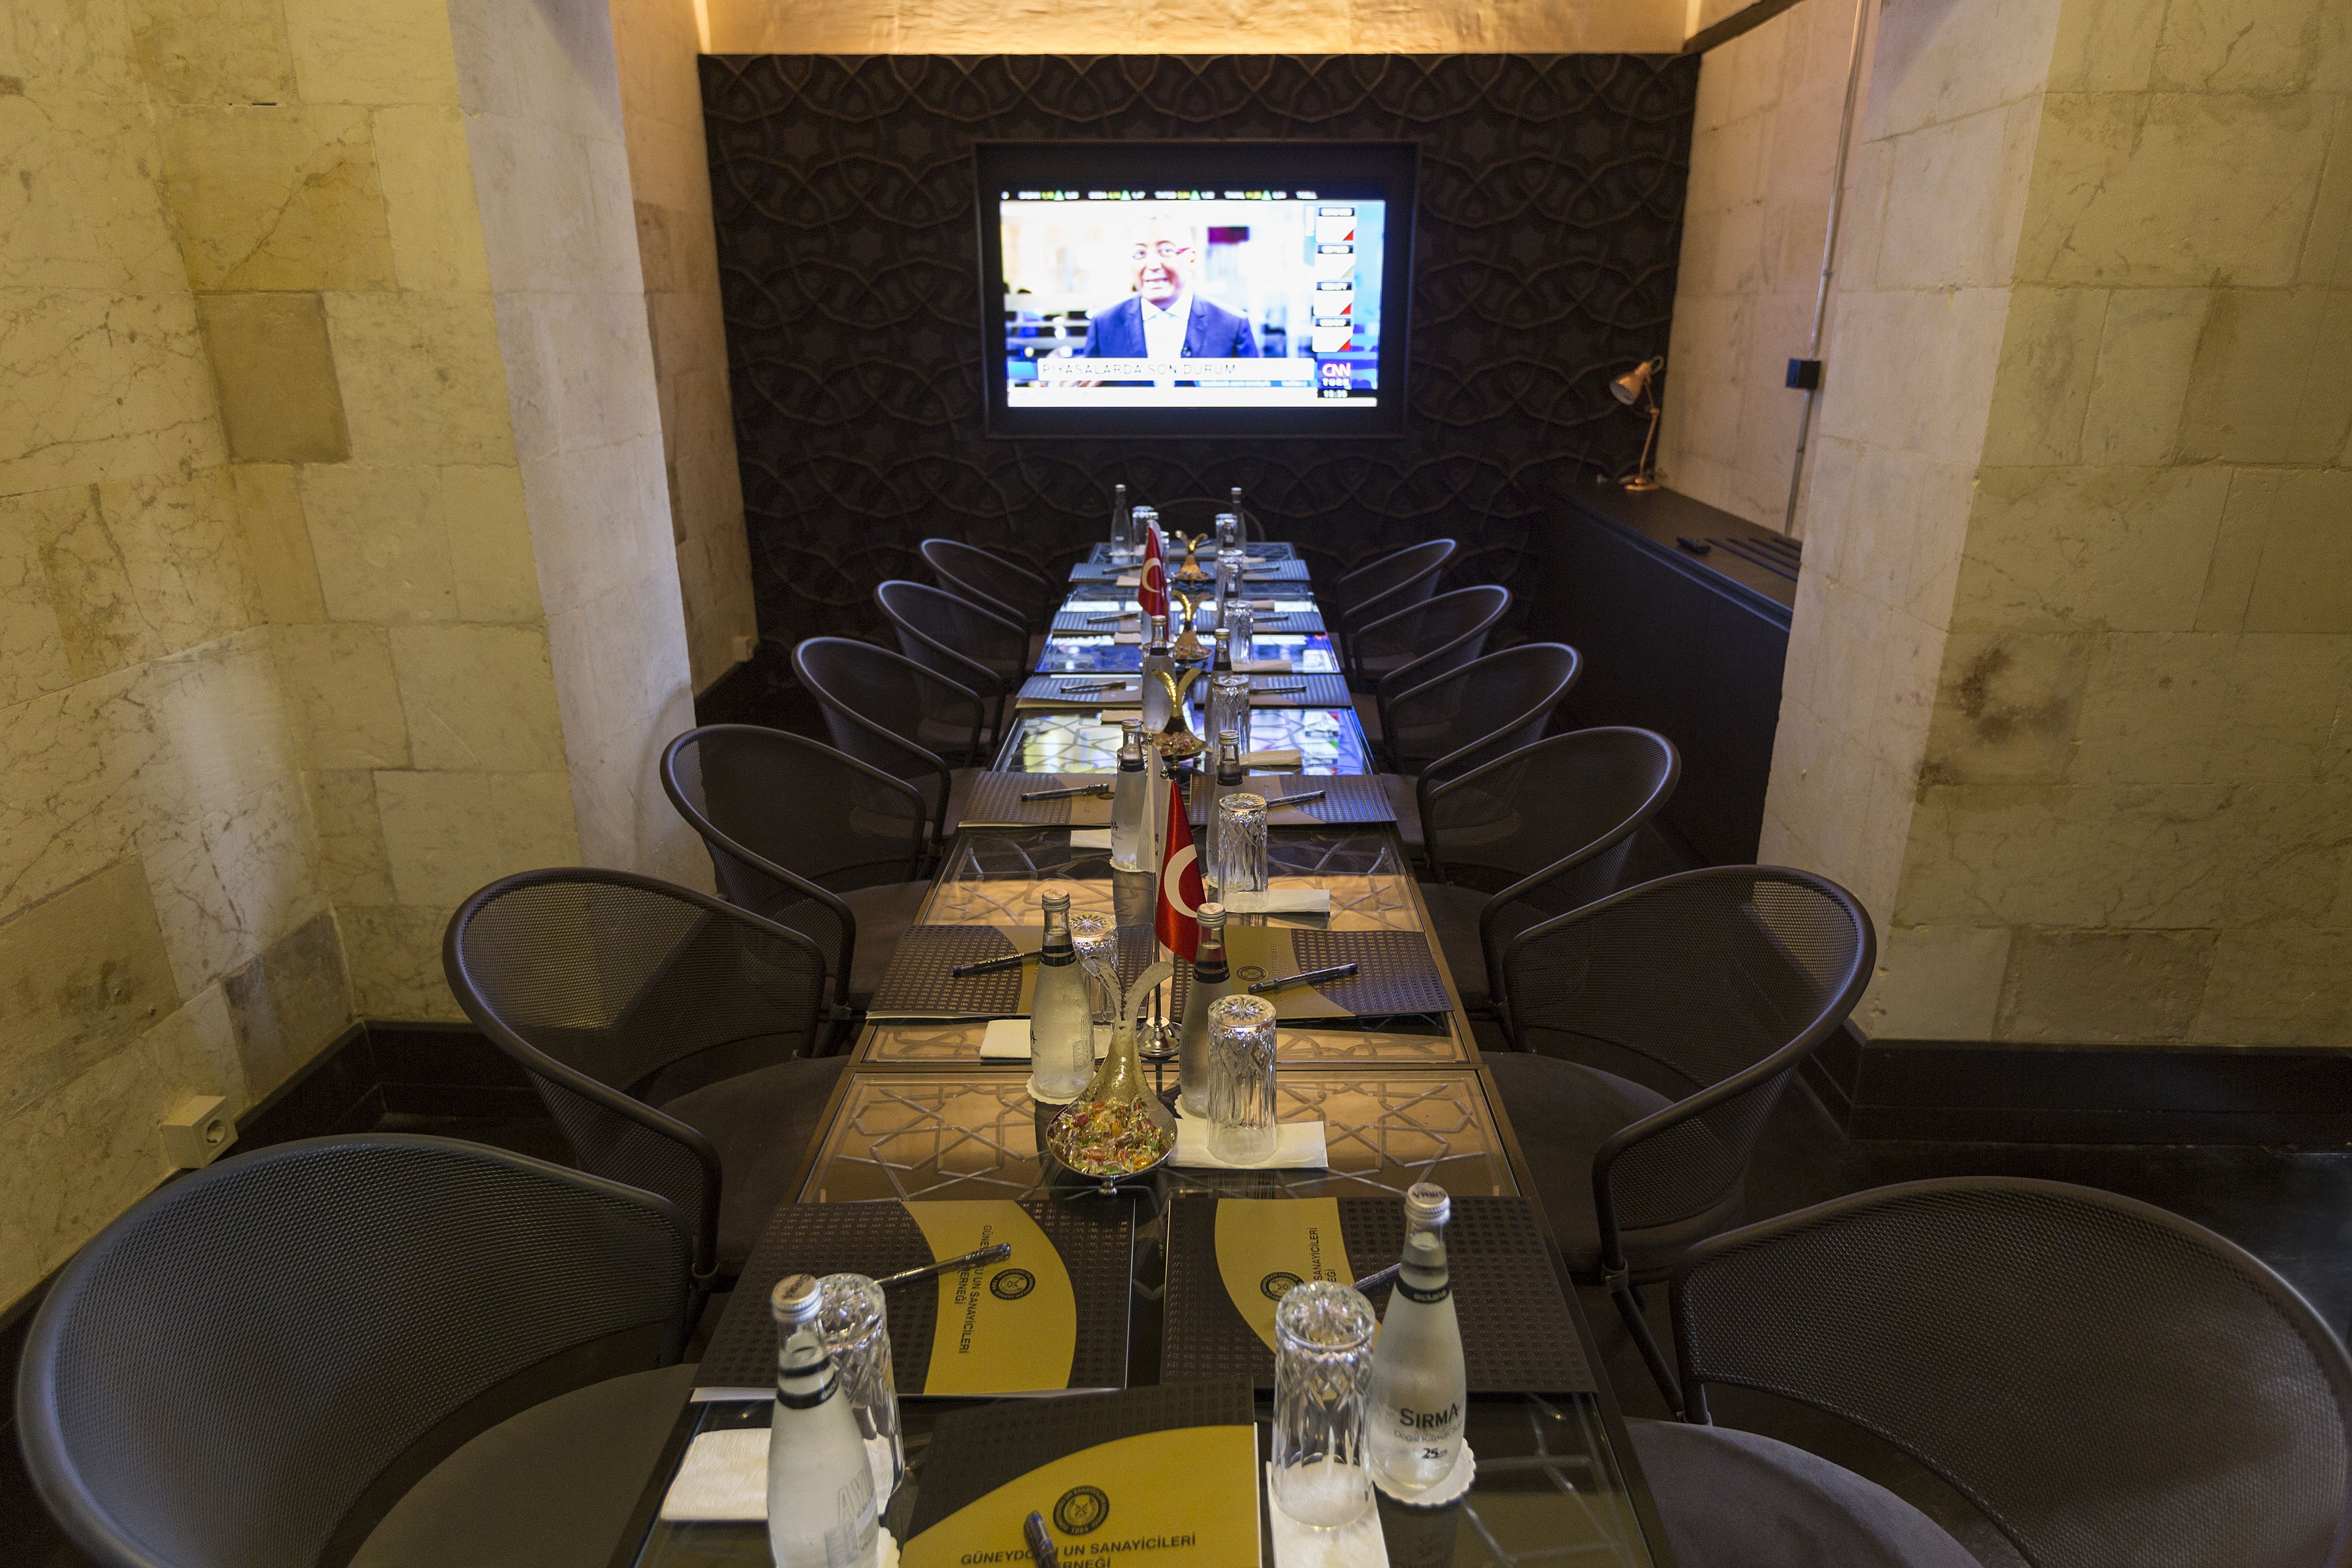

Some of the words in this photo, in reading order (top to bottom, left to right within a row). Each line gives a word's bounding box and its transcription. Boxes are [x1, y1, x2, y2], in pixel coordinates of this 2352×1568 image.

[1148, 364, 1177, 374] SON
[1183, 364, 1236, 374] DURUM
[1322, 363, 1351, 377] CNN
[974, 1225, 993, 1275] GÜNEU
[1306, 1227, 1322, 1281] SANAYİCİLERİ
[954, 1270, 970, 1305] ERNEĞİ
[972, 1277, 982, 1291] UN
[959, 1291, 979, 1354] SANAYİCİLERİ
[1400, 1402, 1460, 1429] SIRMA
[961, 1547, 1058, 1565] GÜNEYDO
[1063, 1544, 1085, 1556] UN
[1090, 1532, 1196, 1554] SANAYİCİLERİ
[1063, 1555, 1111, 1568] RNEĞİ
